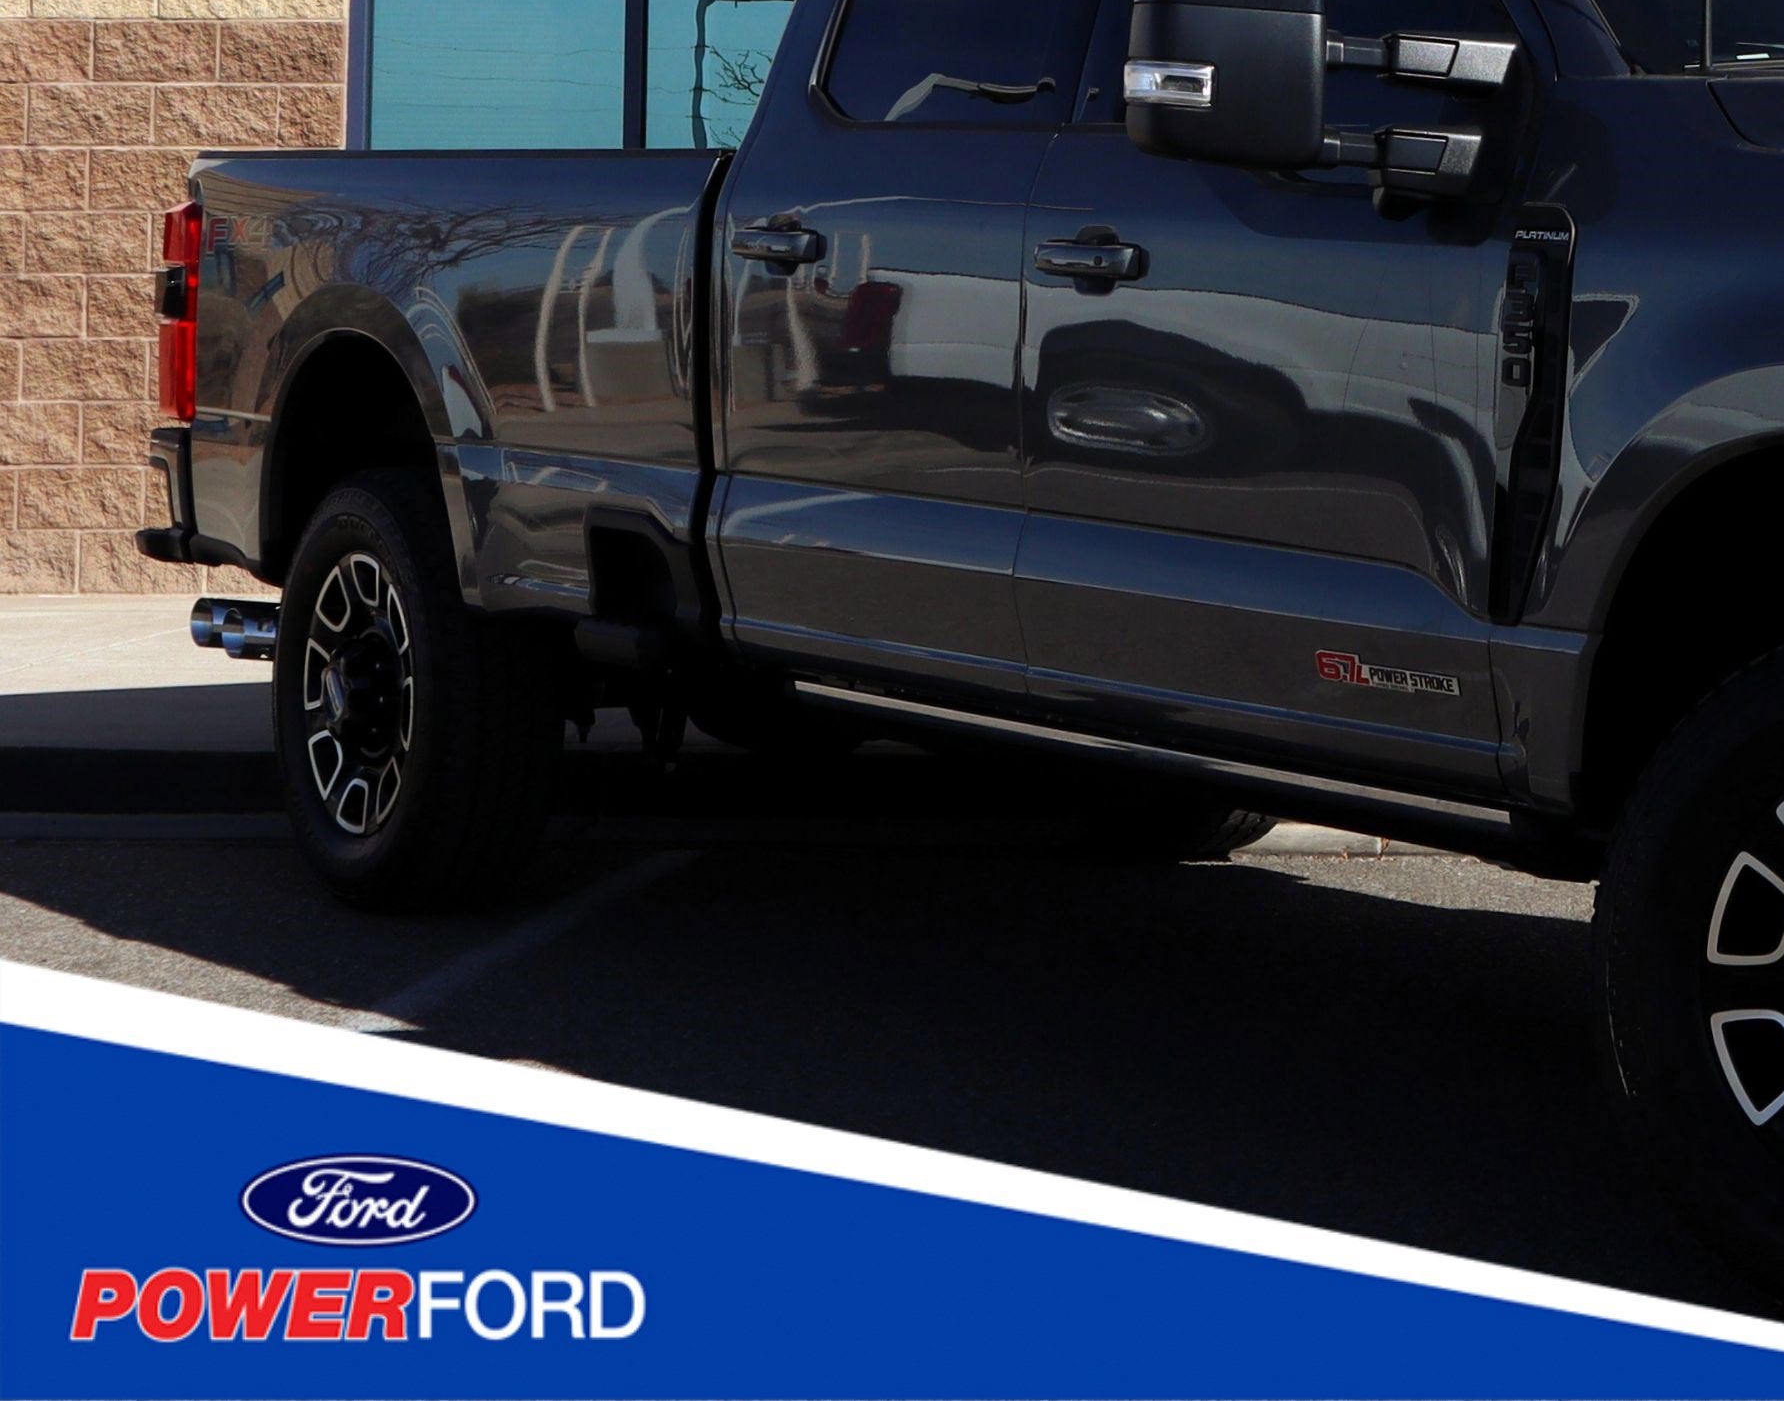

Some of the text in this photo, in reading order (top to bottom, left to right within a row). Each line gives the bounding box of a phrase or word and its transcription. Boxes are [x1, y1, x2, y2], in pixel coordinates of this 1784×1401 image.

[205, 214, 268, 255] FX4
[1514, 230, 1570, 241] PLATINUM
[1369, 666, 1408, 686] POWER
[1409, 672, 1455, 693] STROKE
